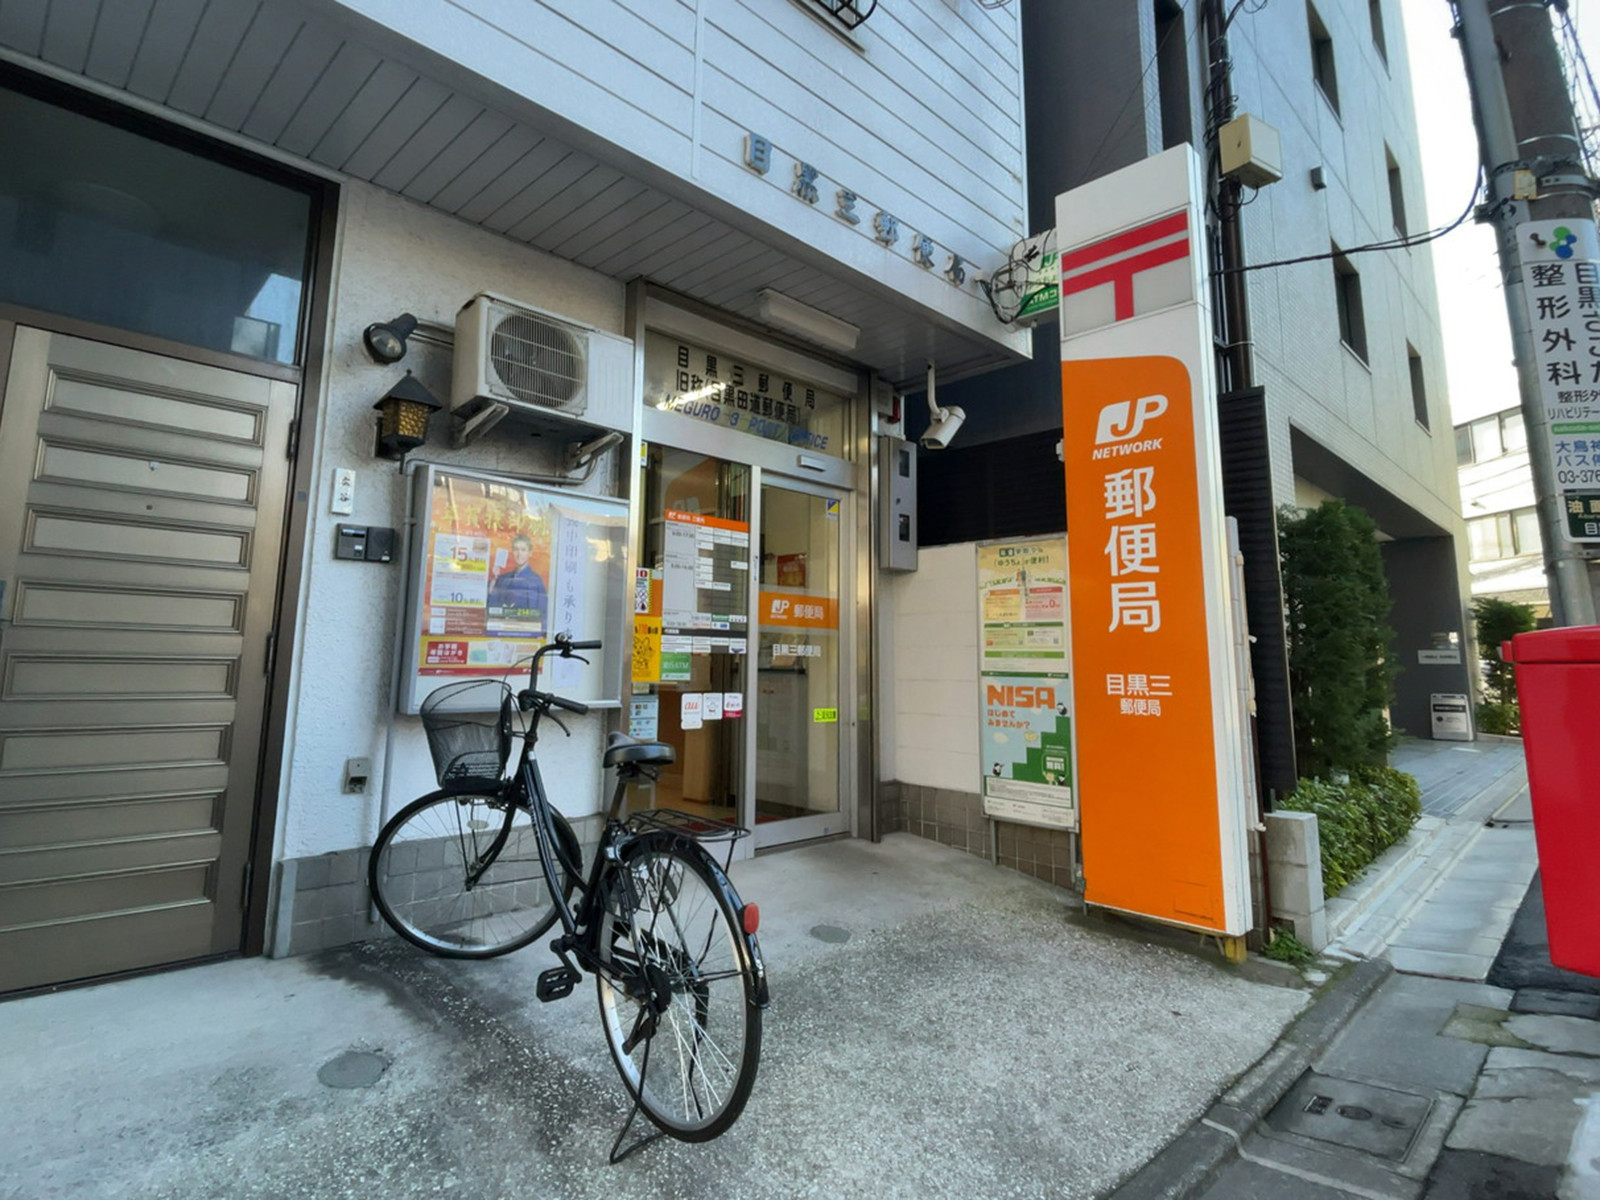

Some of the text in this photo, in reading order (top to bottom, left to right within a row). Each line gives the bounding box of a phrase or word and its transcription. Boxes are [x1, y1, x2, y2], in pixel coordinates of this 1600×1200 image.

[1531, 263, 1582, 386] 整形外科
[678, 346, 815, 410] 目黒三郵便局
[729, 412, 740, 427] 3
[1092, 438, 1163, 460] NETWORK
[1104, 466, 1161, 633] 郵便局
[794, 604, 824, 620] 郵便局
[1106, 674, 1173, 696] 目黒三
[987, 685, 1055, 709] NISA
[1120, 699, 1161, 717] 郵便局
